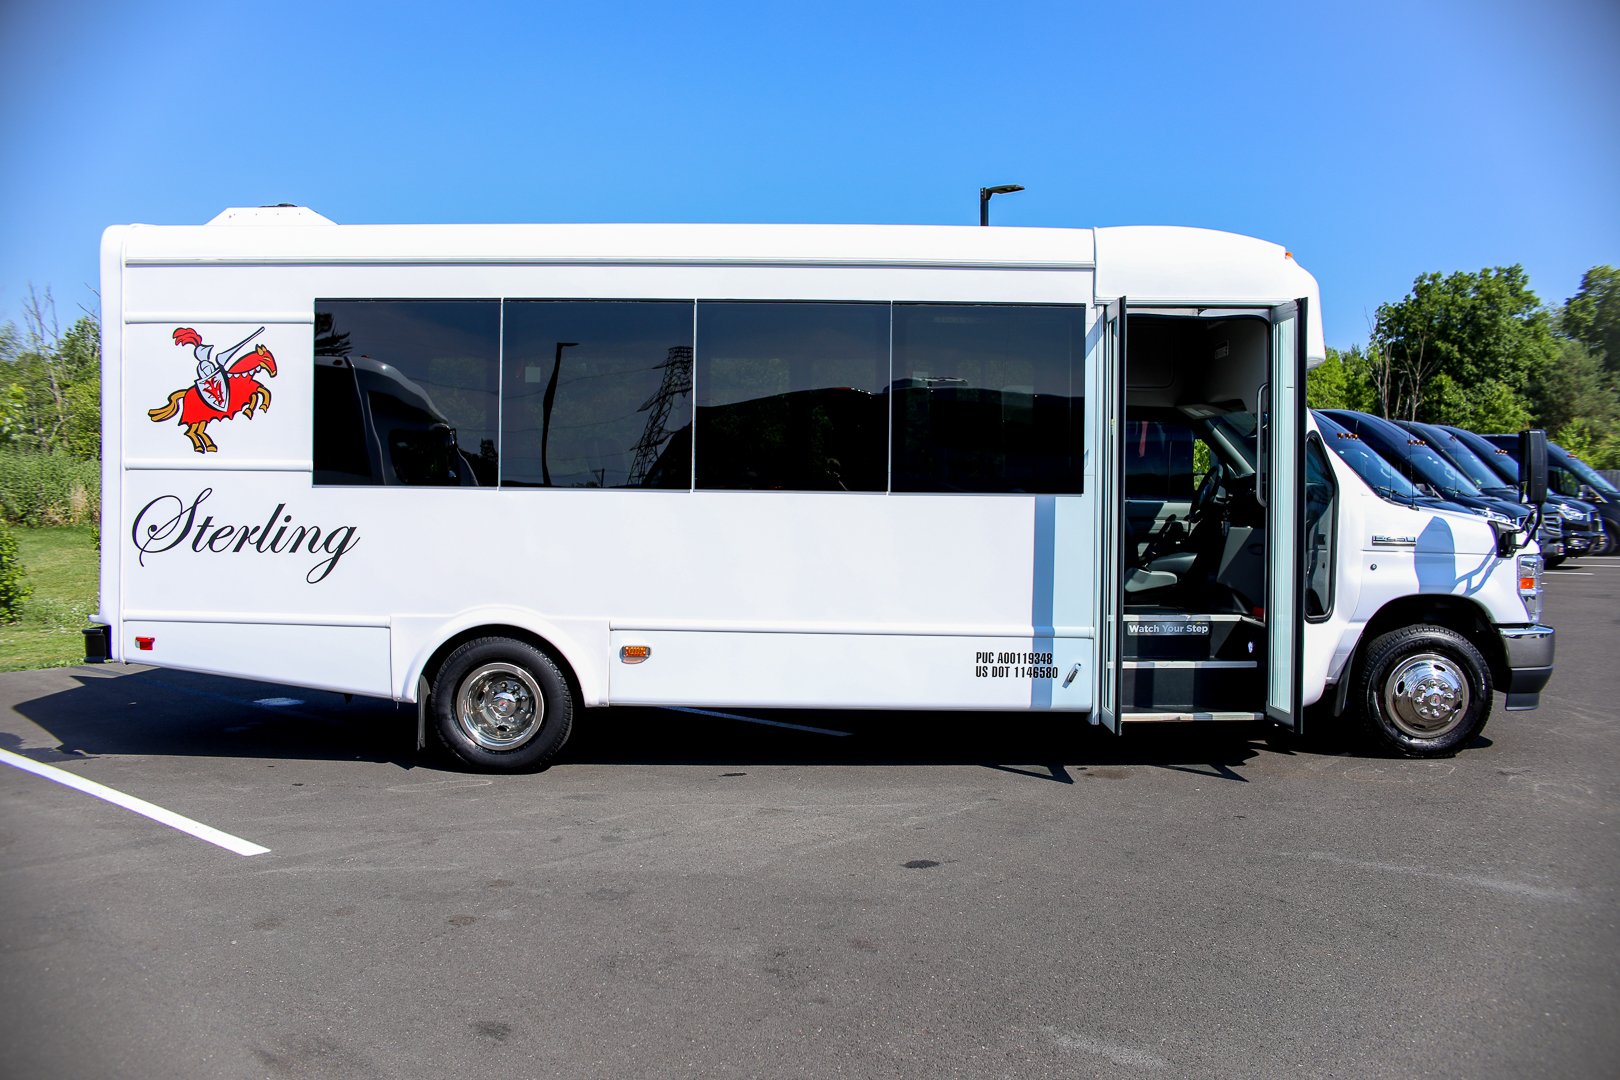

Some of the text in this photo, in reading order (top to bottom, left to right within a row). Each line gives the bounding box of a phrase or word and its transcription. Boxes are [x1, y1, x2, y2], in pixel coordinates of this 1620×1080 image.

[131, 487, 361, 584] Sterling
[1129, 624, 1209, 634] Watch Your Step
[975, 651, 1053, 665] PUC A00119348
[975, 665, 1058, 679] US DOT 1146580
